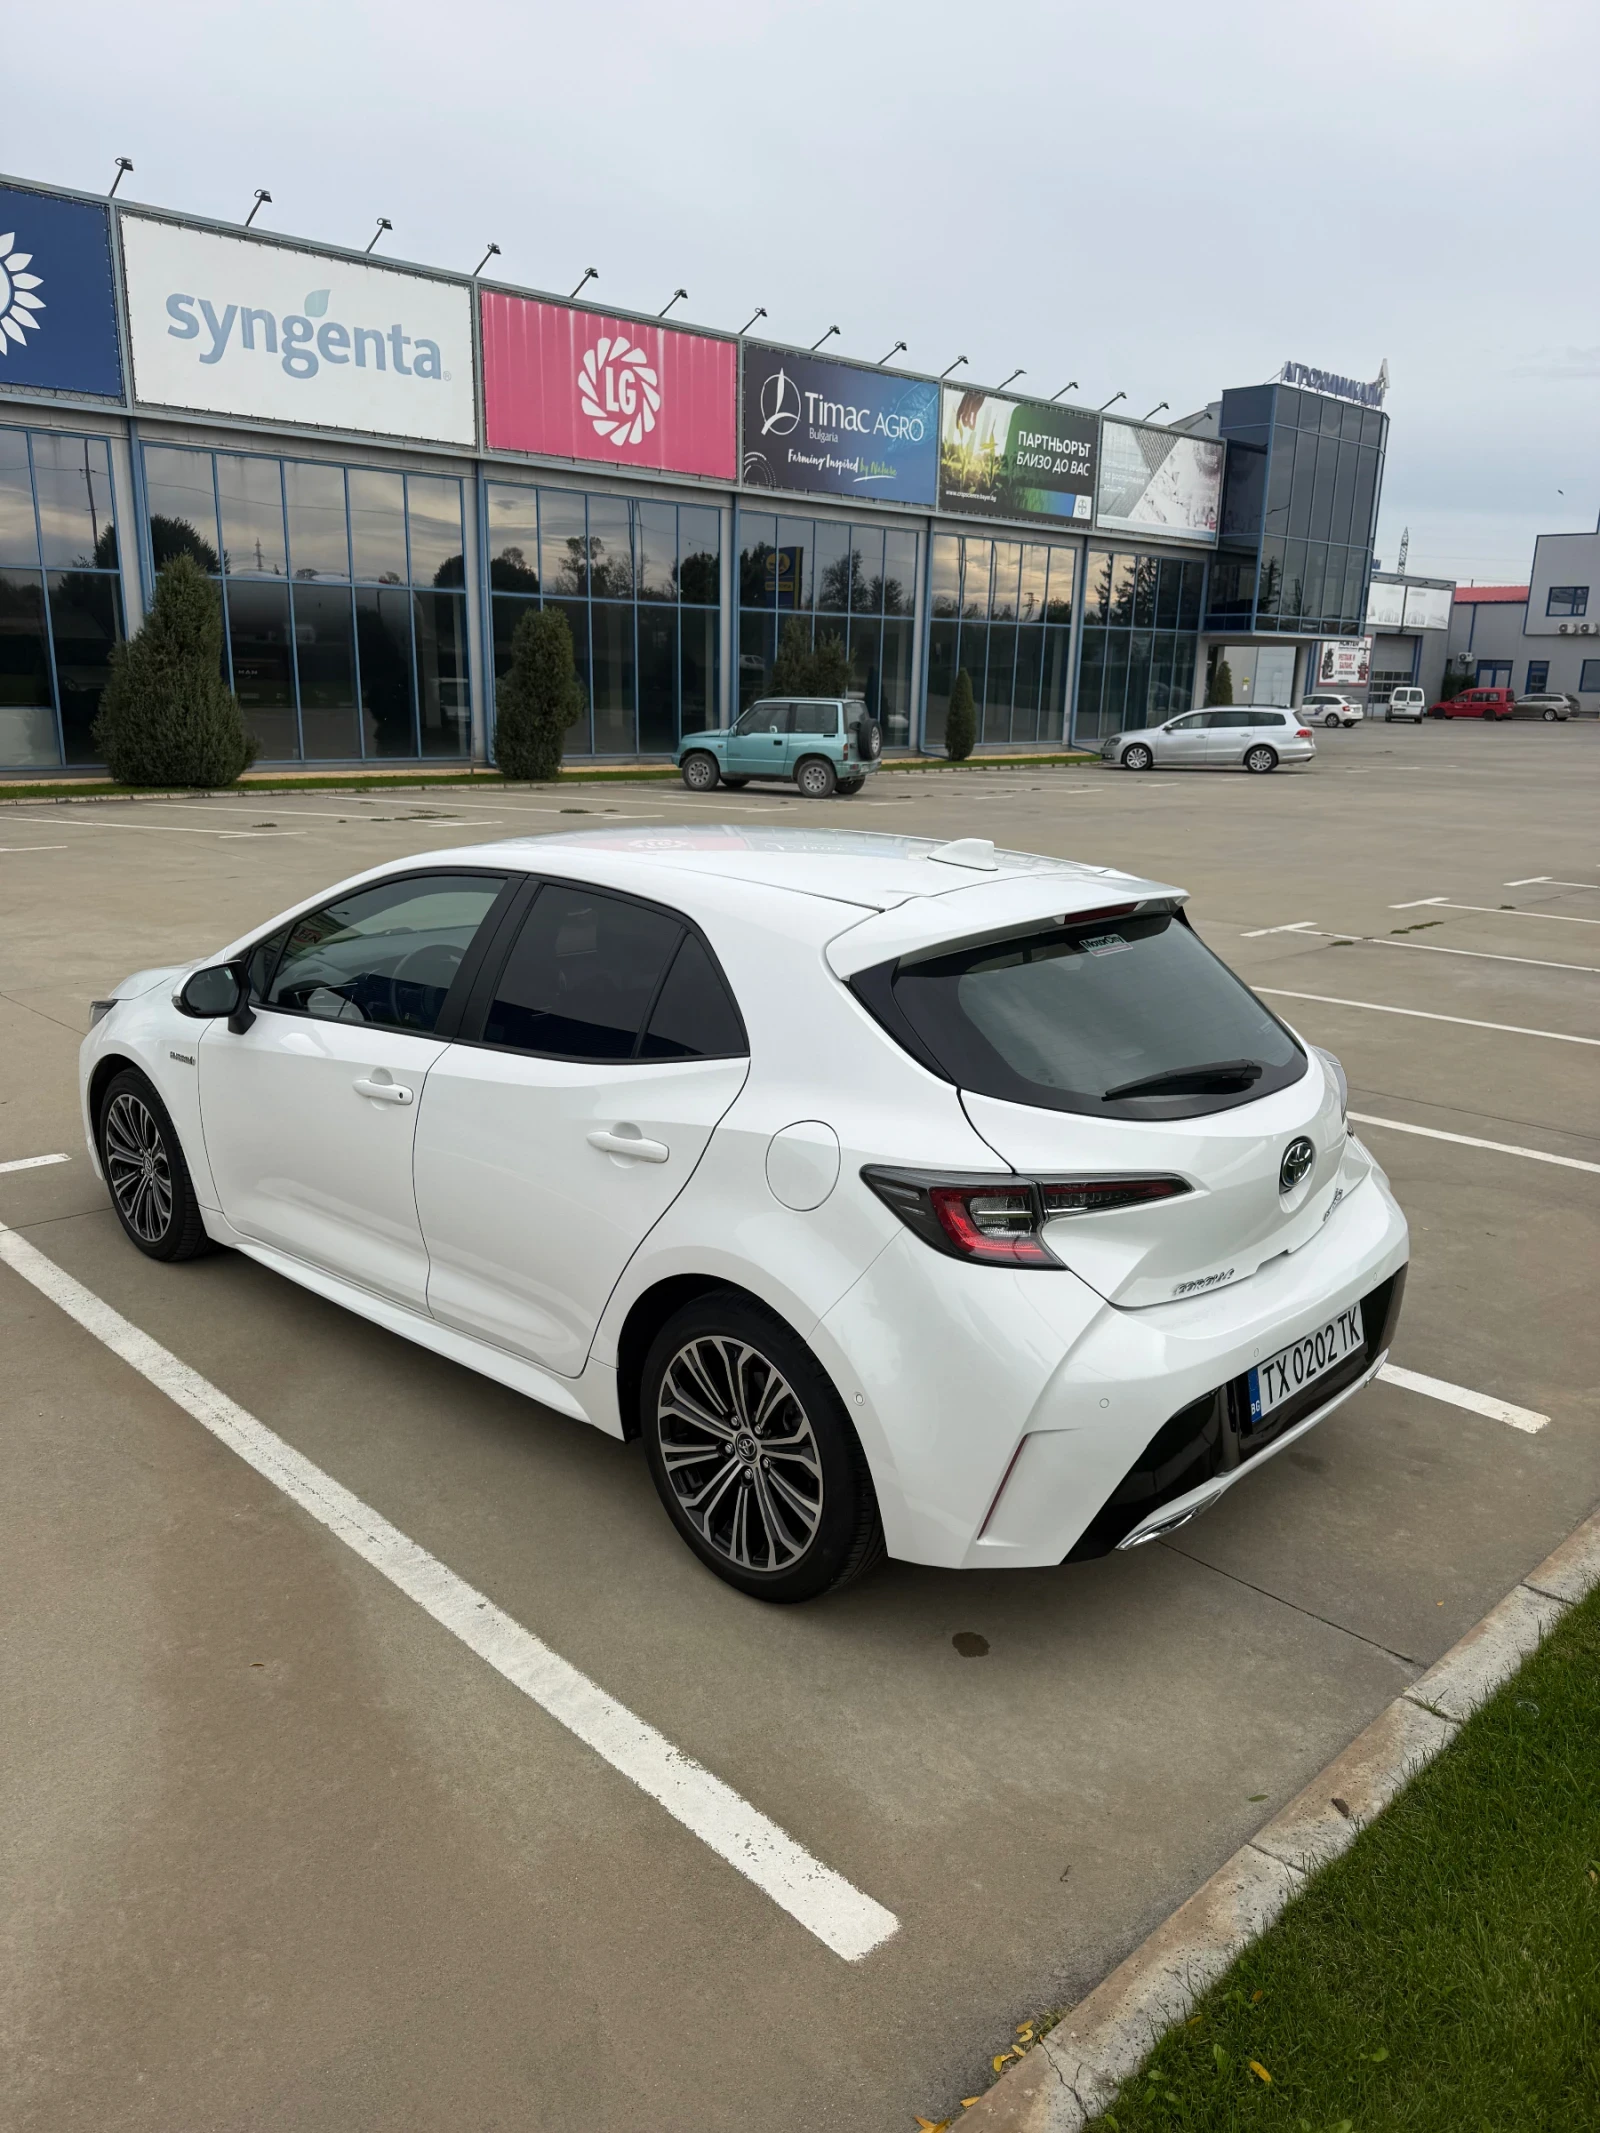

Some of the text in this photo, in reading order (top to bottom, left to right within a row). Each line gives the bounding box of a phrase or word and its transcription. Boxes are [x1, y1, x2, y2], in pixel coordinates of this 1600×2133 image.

[165, 292, 442, 380] syngenta
[605, 366, 636, 415] LG
[804, 391, 924, 442] Timac AGRO
[809, 428, 839, 443] Bulgaria
[1018, 430, 1092, 458] ПАРТНЬОРЪТ
[787, 448, 826, 471] Farming
[825, 453, 860, 475] Inspired
[1016, 451, 1052, 470] БЛИЗО
[1052, 458, 1069, 475] ДО
[1069, 461, 1091, 477] ВАС
[1262, 1306, 1361, 1404] TX 0202 TK
[1250, 1400, 1261, 1415] BG
